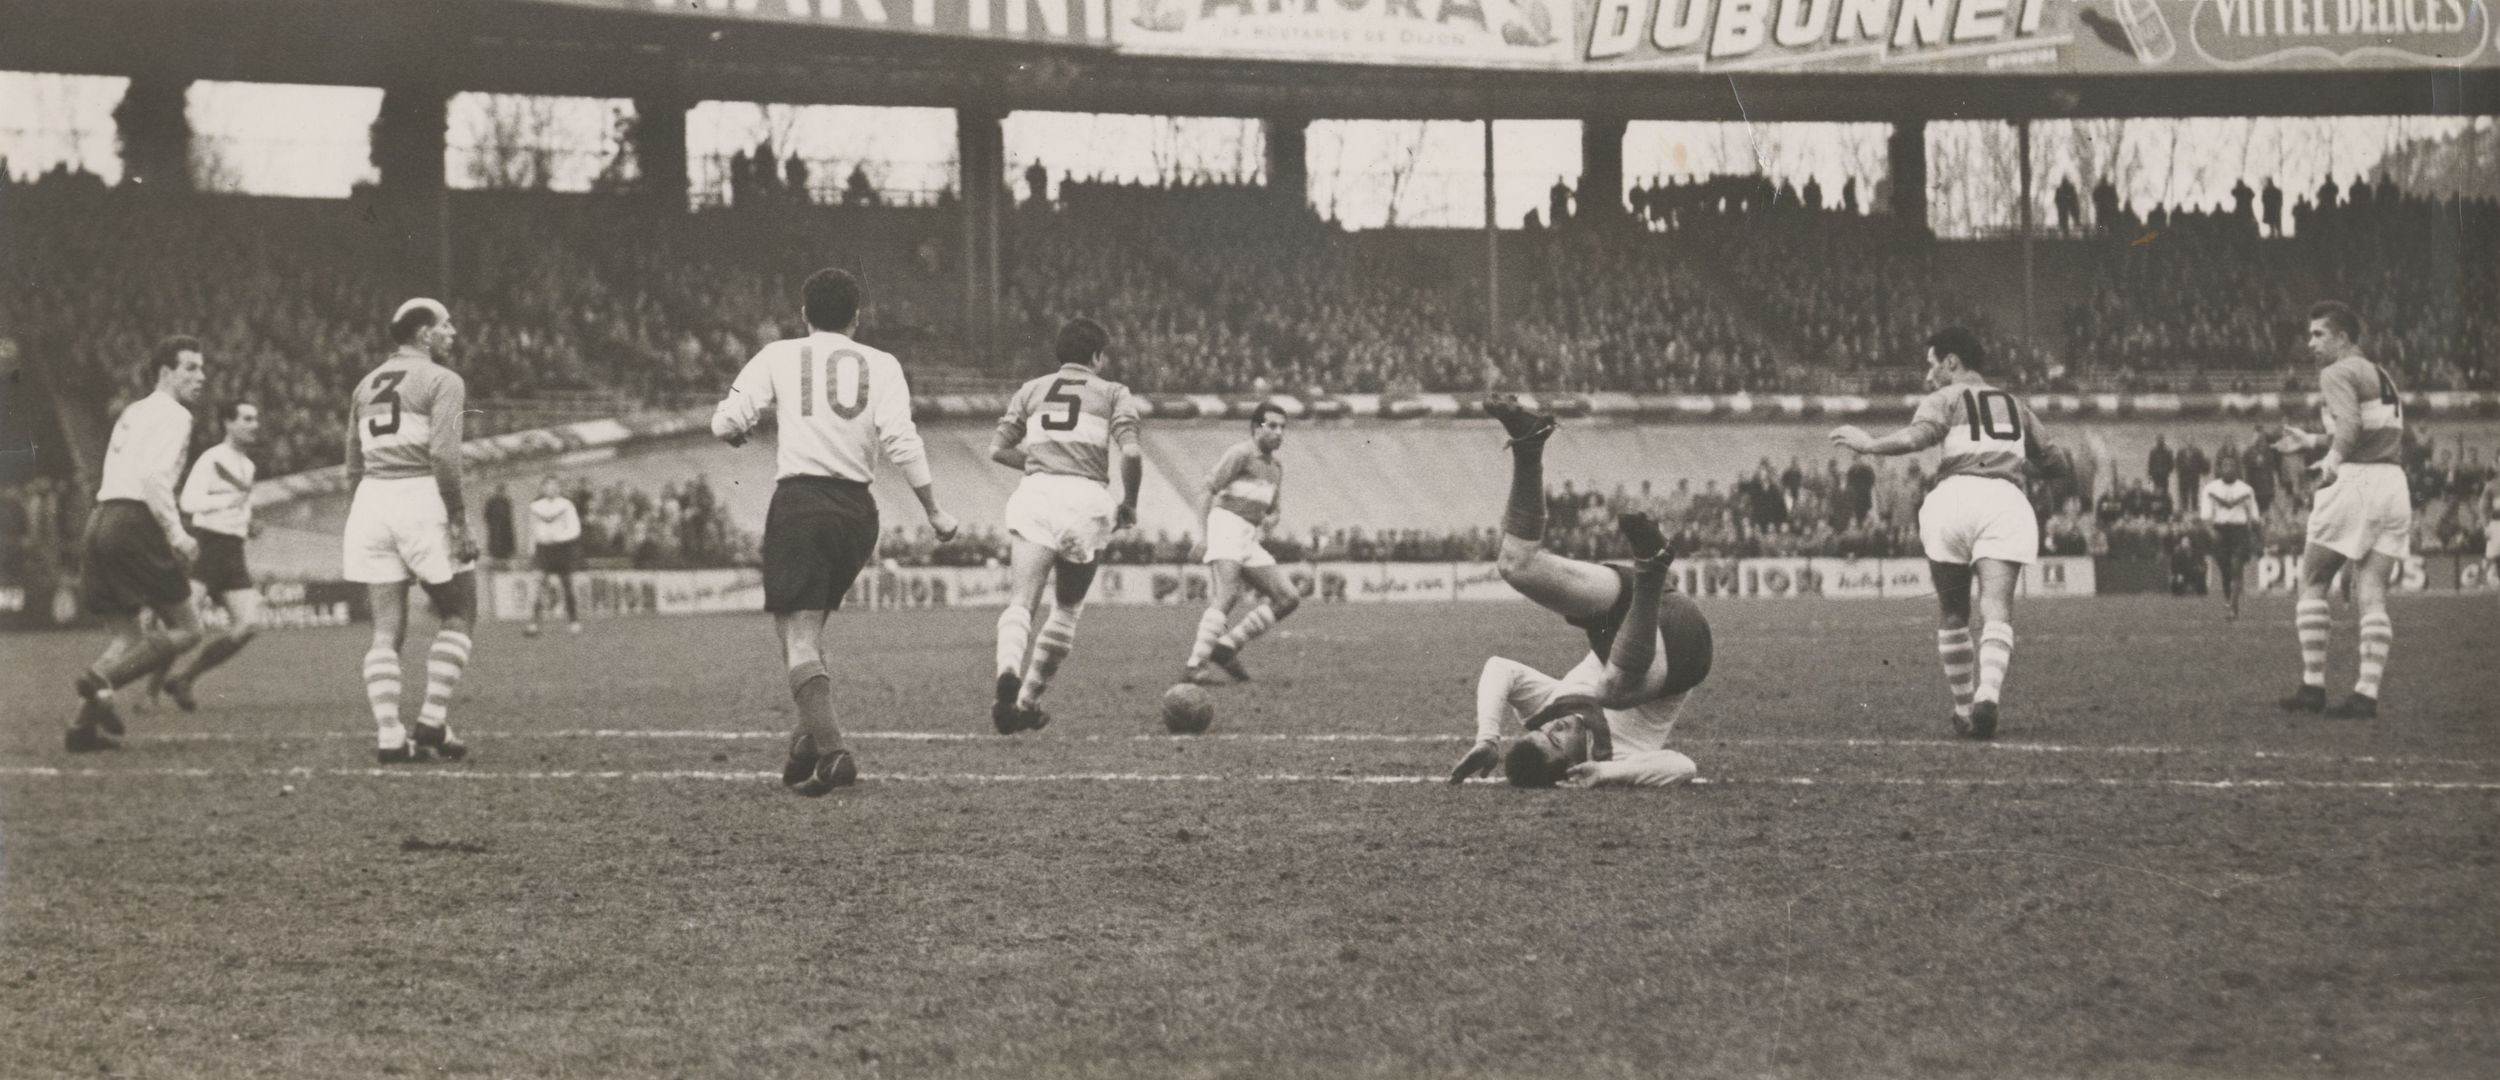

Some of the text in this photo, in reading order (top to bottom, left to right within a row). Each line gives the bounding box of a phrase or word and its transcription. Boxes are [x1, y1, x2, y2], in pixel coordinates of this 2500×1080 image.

[369, 370, 408, 438] 3
[800, 345, 870, 421] 10
[1041, 378, 1087, 431] 5
[1963, 388, 2021, 442] 10
